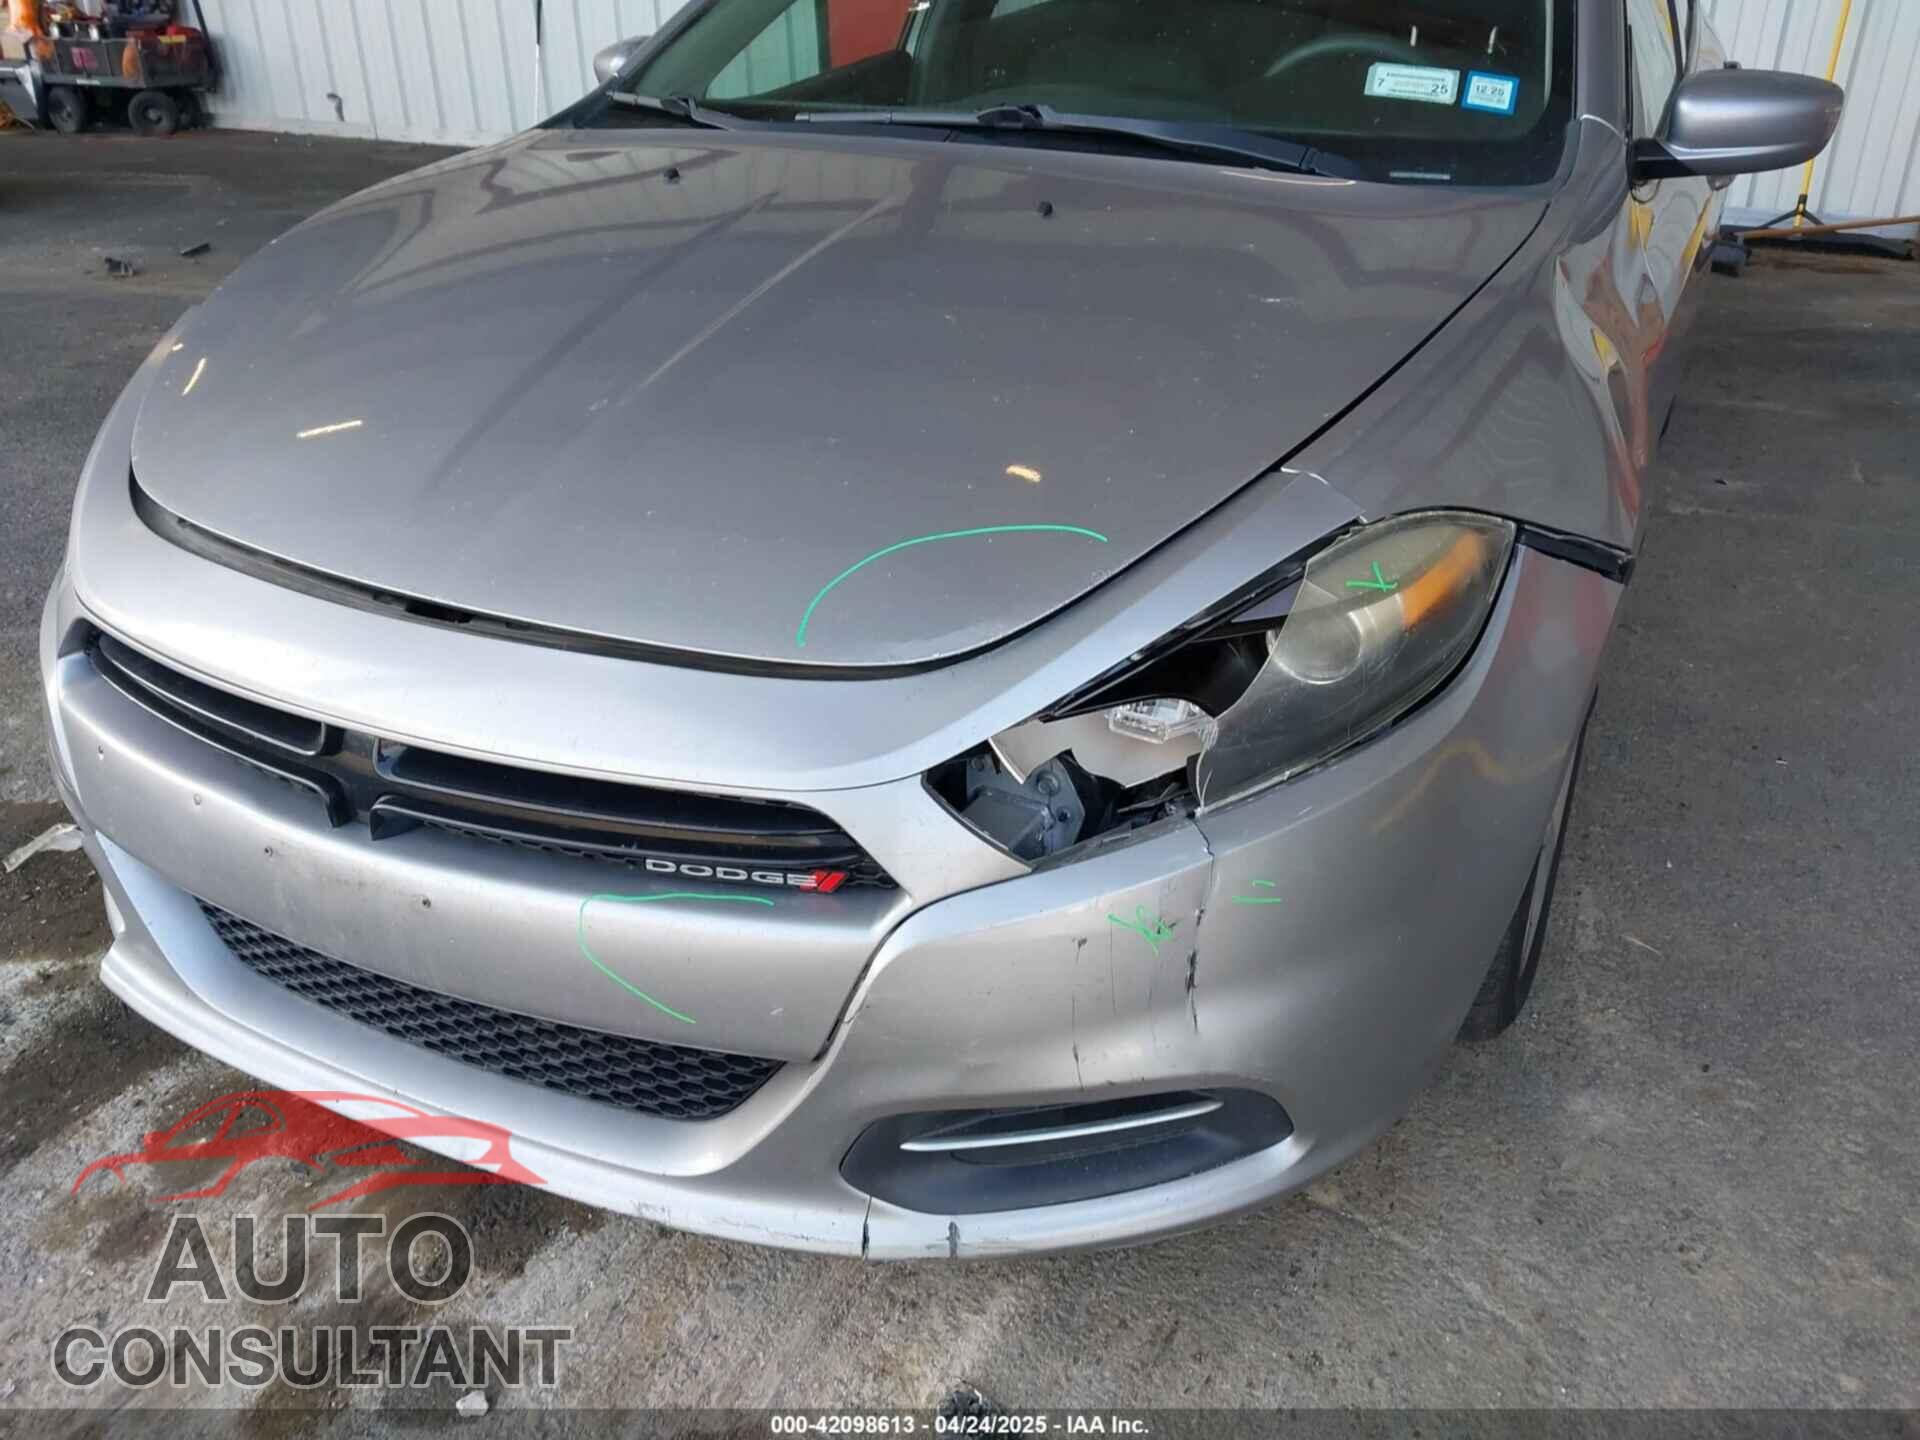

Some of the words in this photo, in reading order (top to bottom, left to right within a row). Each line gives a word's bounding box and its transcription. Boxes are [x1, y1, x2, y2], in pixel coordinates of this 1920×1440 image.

[1377, 78, 1385, 88] 7
[1431, 84, 1448, 95] 25
[645, 858, 818, 887] DODGE
